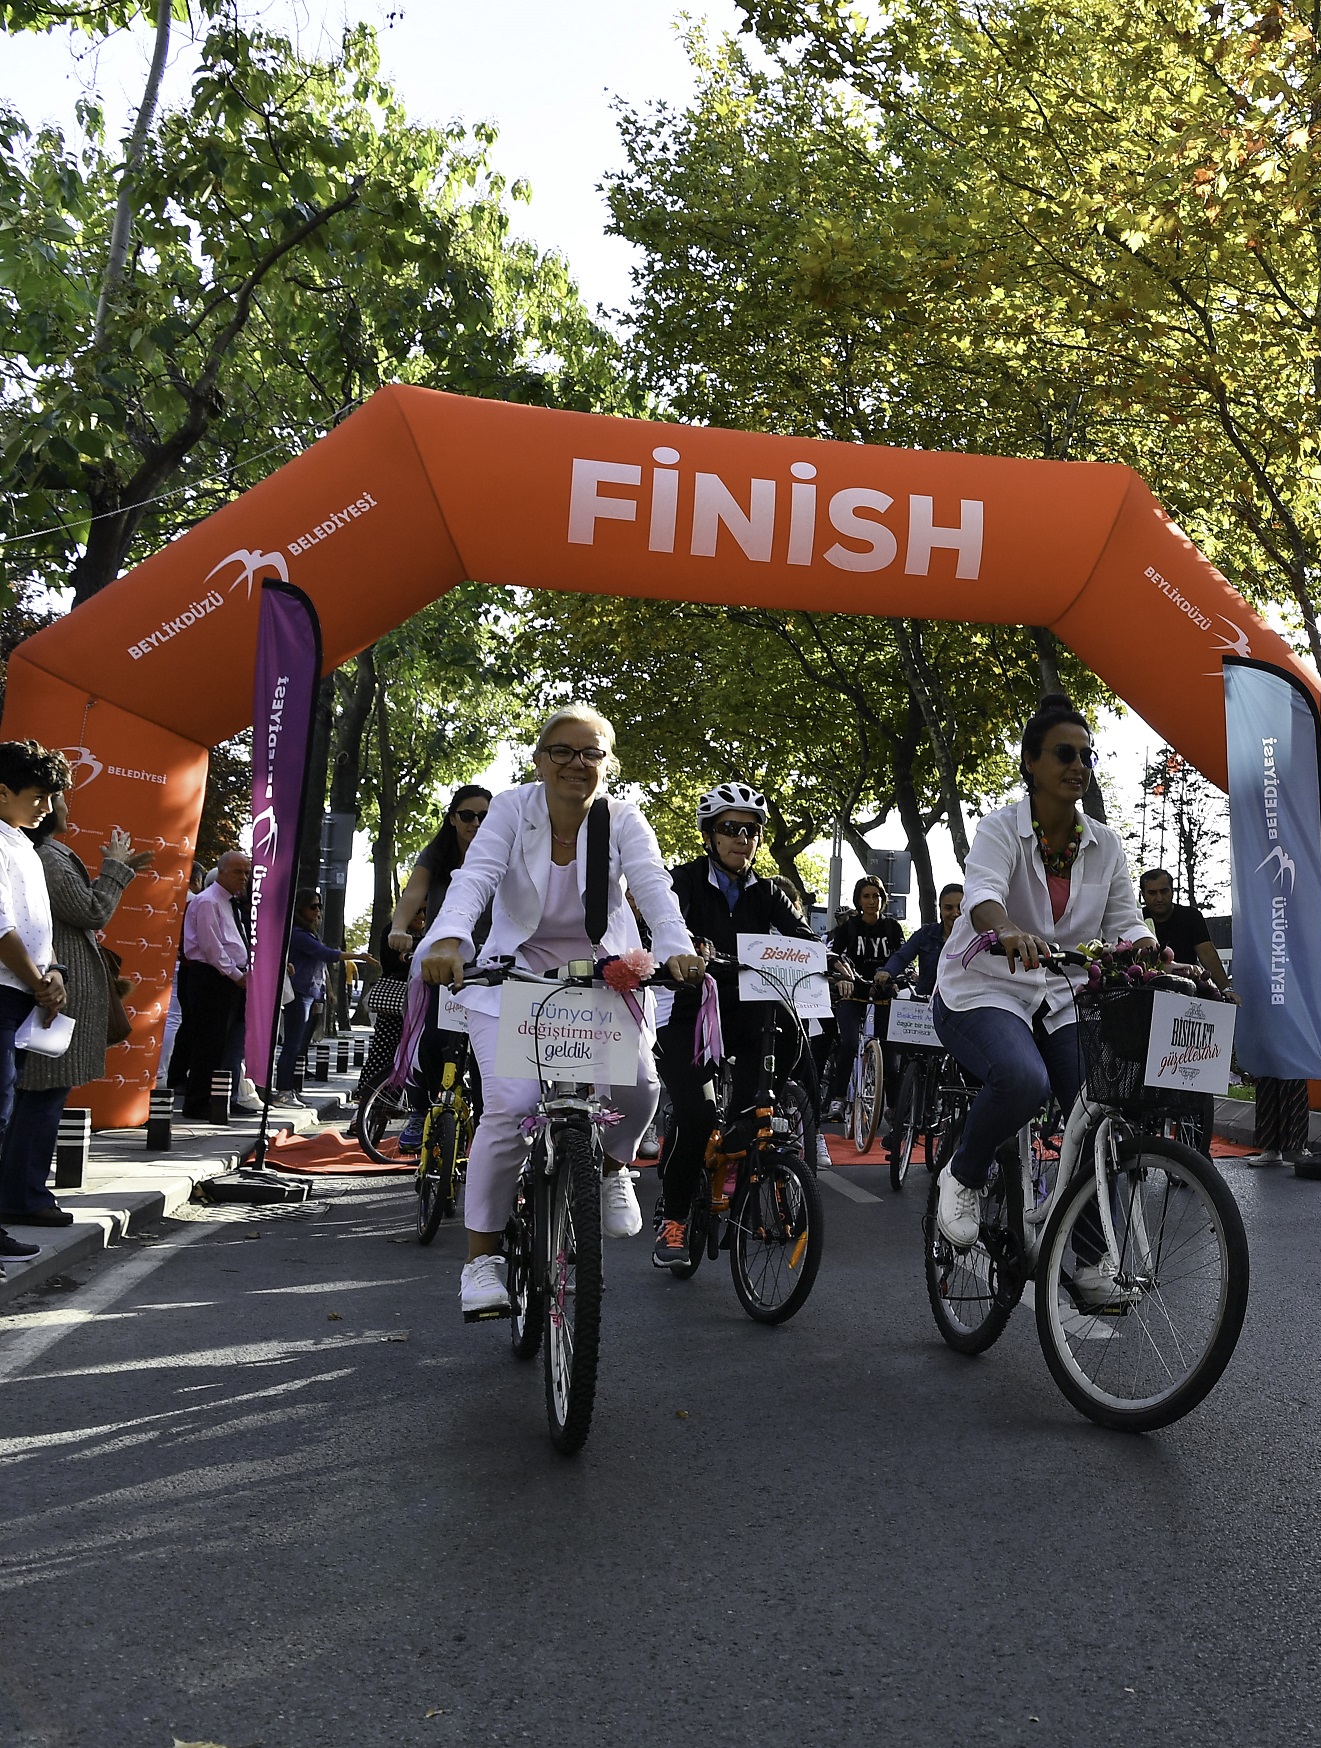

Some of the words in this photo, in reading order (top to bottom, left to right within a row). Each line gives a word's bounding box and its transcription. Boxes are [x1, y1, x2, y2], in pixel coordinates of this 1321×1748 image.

[127, 590, 225, 660] BEYLİKDÜZÜ
[287, 491, 379, 557] BELEDİYESİ
[1143, 566, 1213, 631] BEYLİKDÜZÜ
[107, 765, 167, 785] BELEDİYESİ
[760, 946, 811, 964] Bisiklet
[530, 1002, 613, 1025] Dünya'yı
[517, 1020, 622, 1044] değiştirmeye
[1171, 1016, 1215, 1049] BİSİKLET
[544, 1041, 592, 1061] geldik
